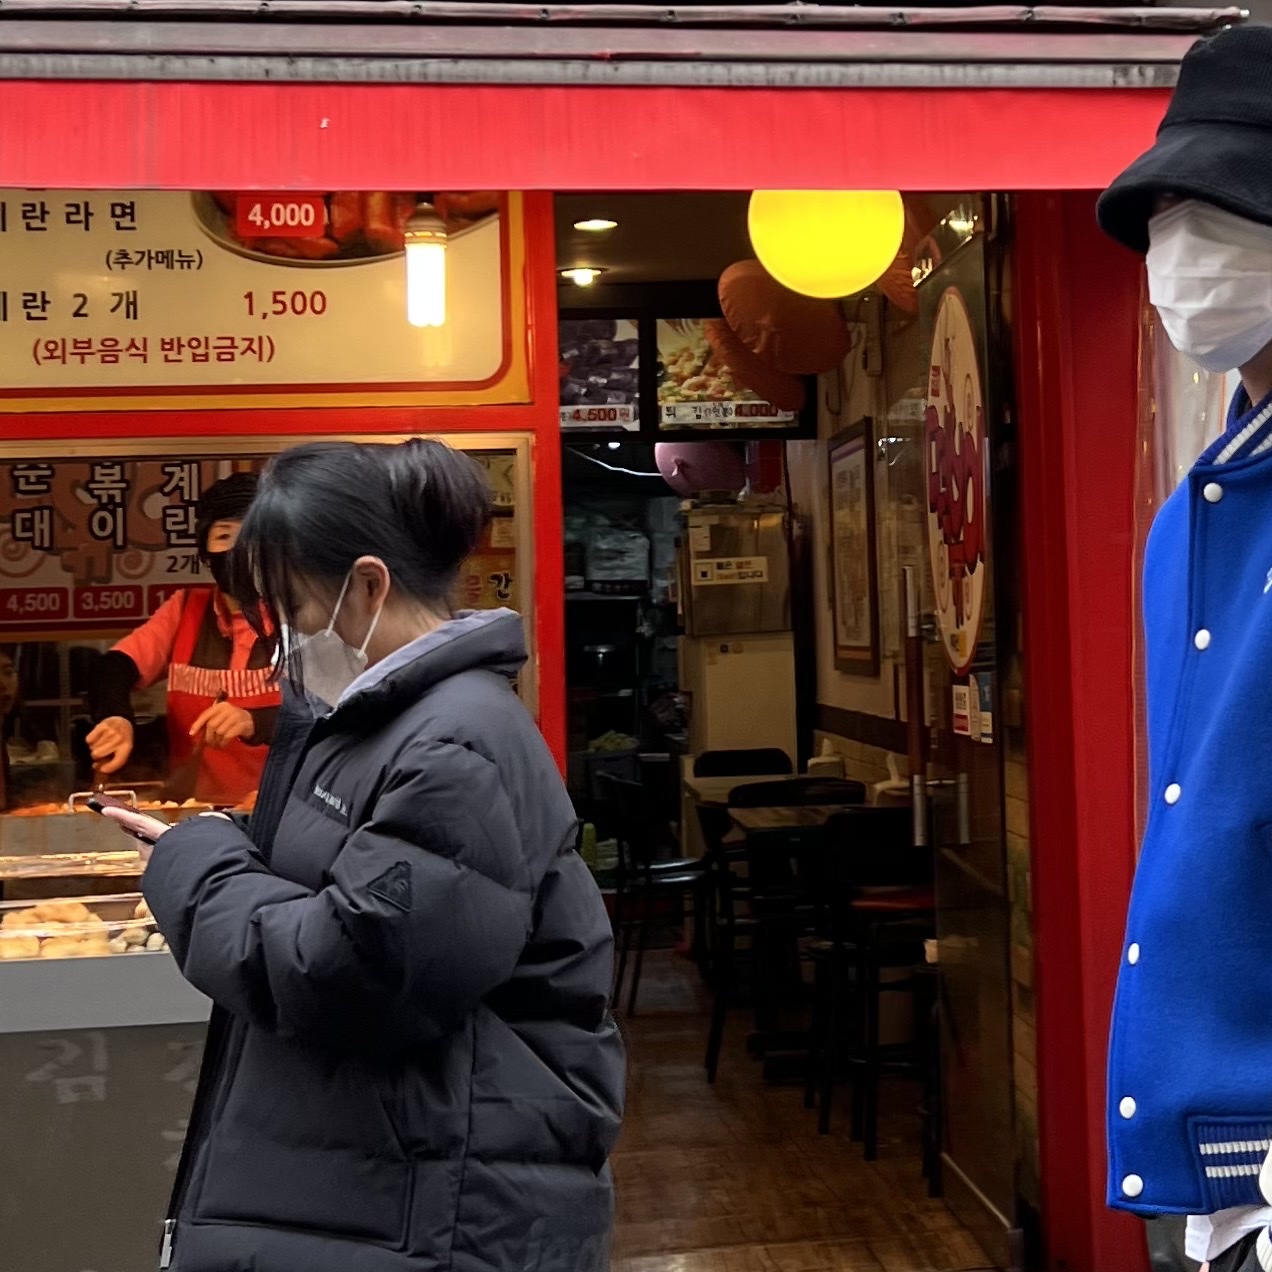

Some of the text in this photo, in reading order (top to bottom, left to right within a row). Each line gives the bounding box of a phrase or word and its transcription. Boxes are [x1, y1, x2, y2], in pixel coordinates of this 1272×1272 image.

[248, 203, 315, 229] 4,000
[105, 249, 204, 271] (추가메뉴)
[243, 290, 327, 320] 1,500
[33, 335, 275, 366] (외부음식 반입금지)
[6, 591, 62, 614] 4,500
[80, 589, 135, 612] 3,500
